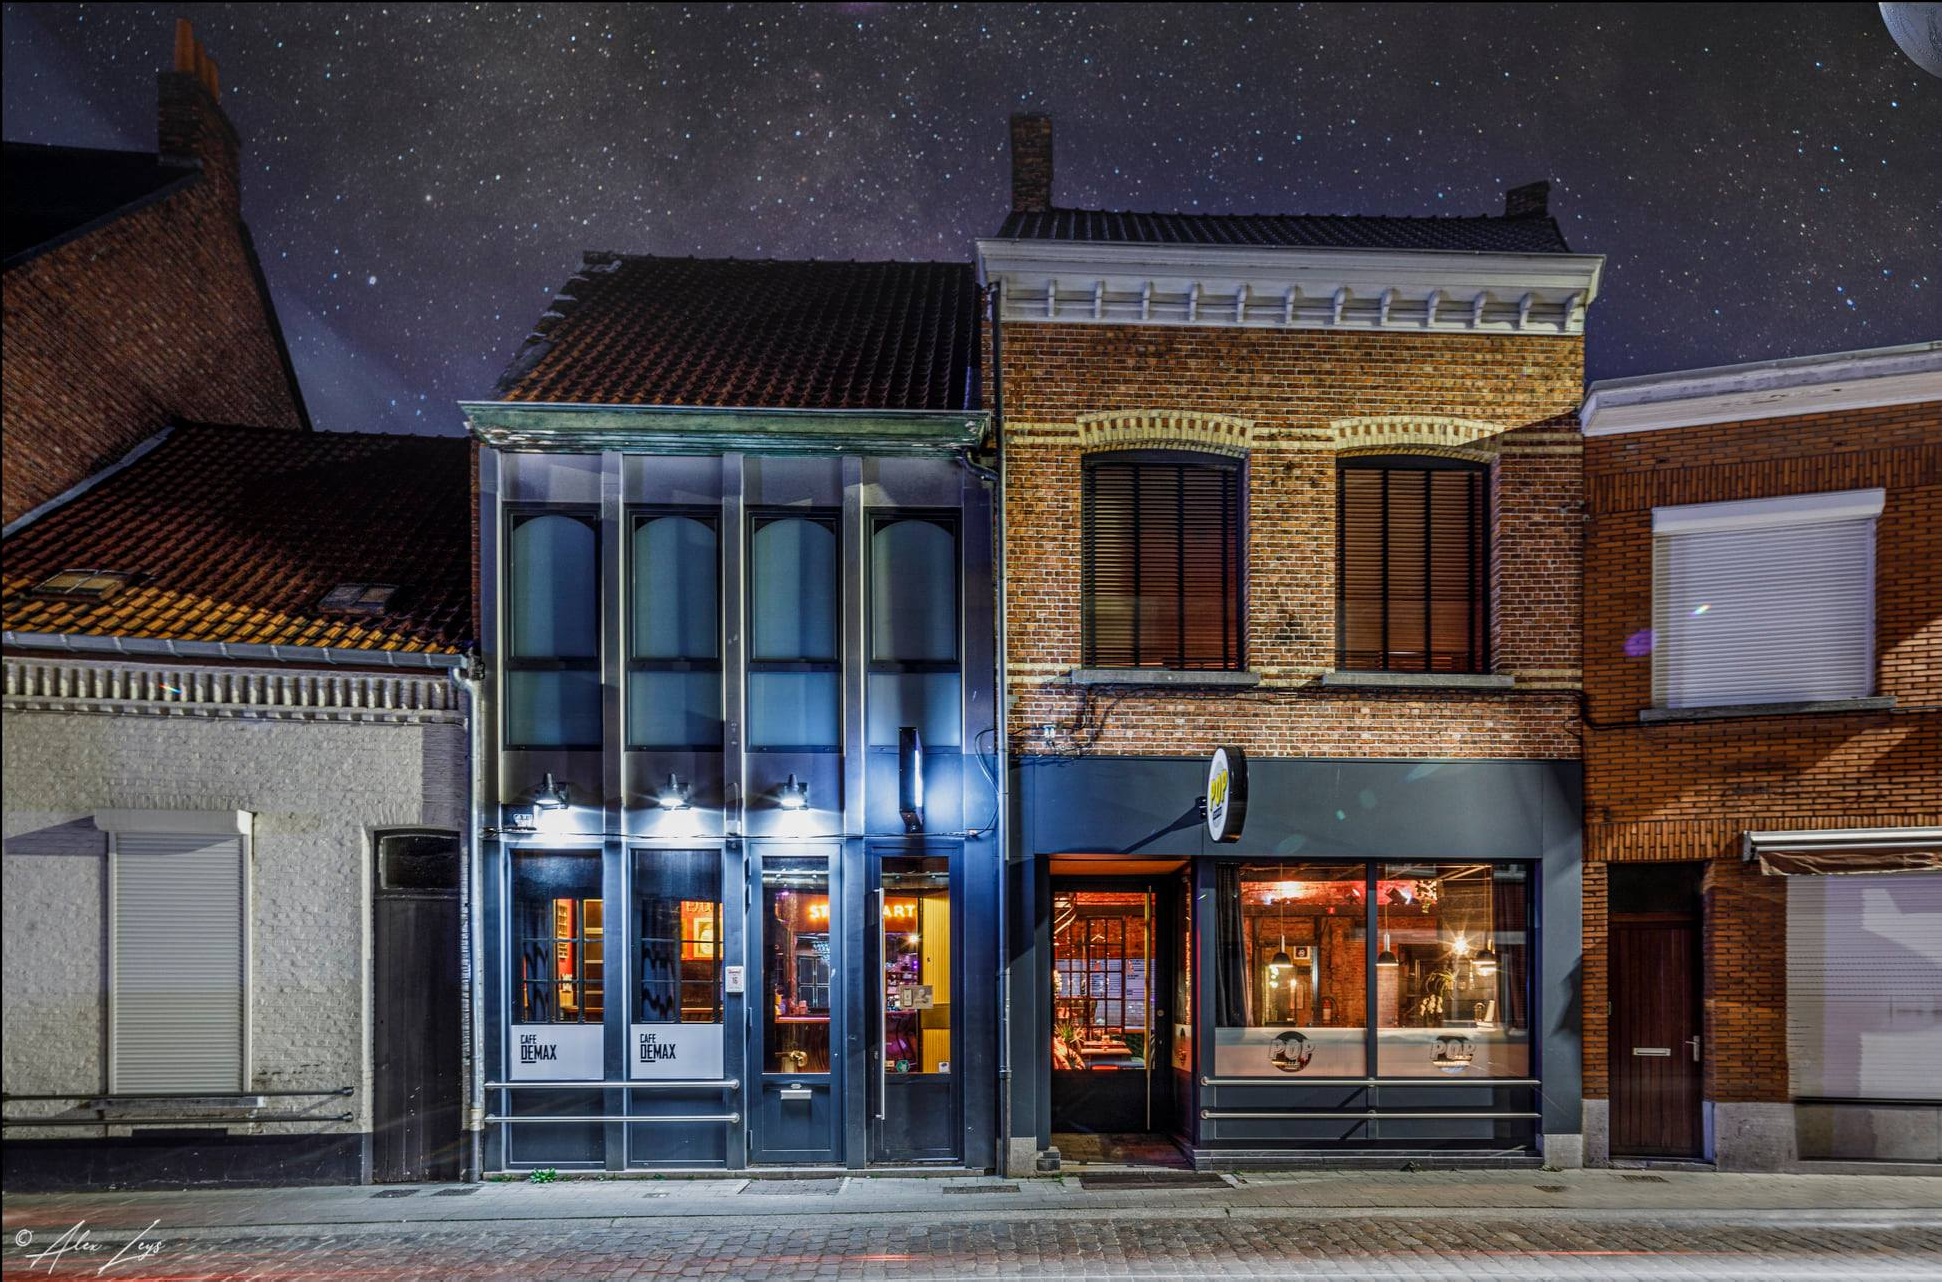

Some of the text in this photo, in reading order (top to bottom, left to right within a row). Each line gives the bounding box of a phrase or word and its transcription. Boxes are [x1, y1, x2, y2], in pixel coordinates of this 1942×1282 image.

[1210, 768, 1228, 811] POP
[883, 904, 916, 918] ART
[520, 1034, 537, 1044] CAFE
[640, 1033, 656, 1043] CAFE
[521, 1045, 557, 1060] DEMAX
[640, 1044, 676, 1059] DEMAX
[1268, 1038, 1316, 1060] POP
[1430, 1039, 1477, 1060] POP
